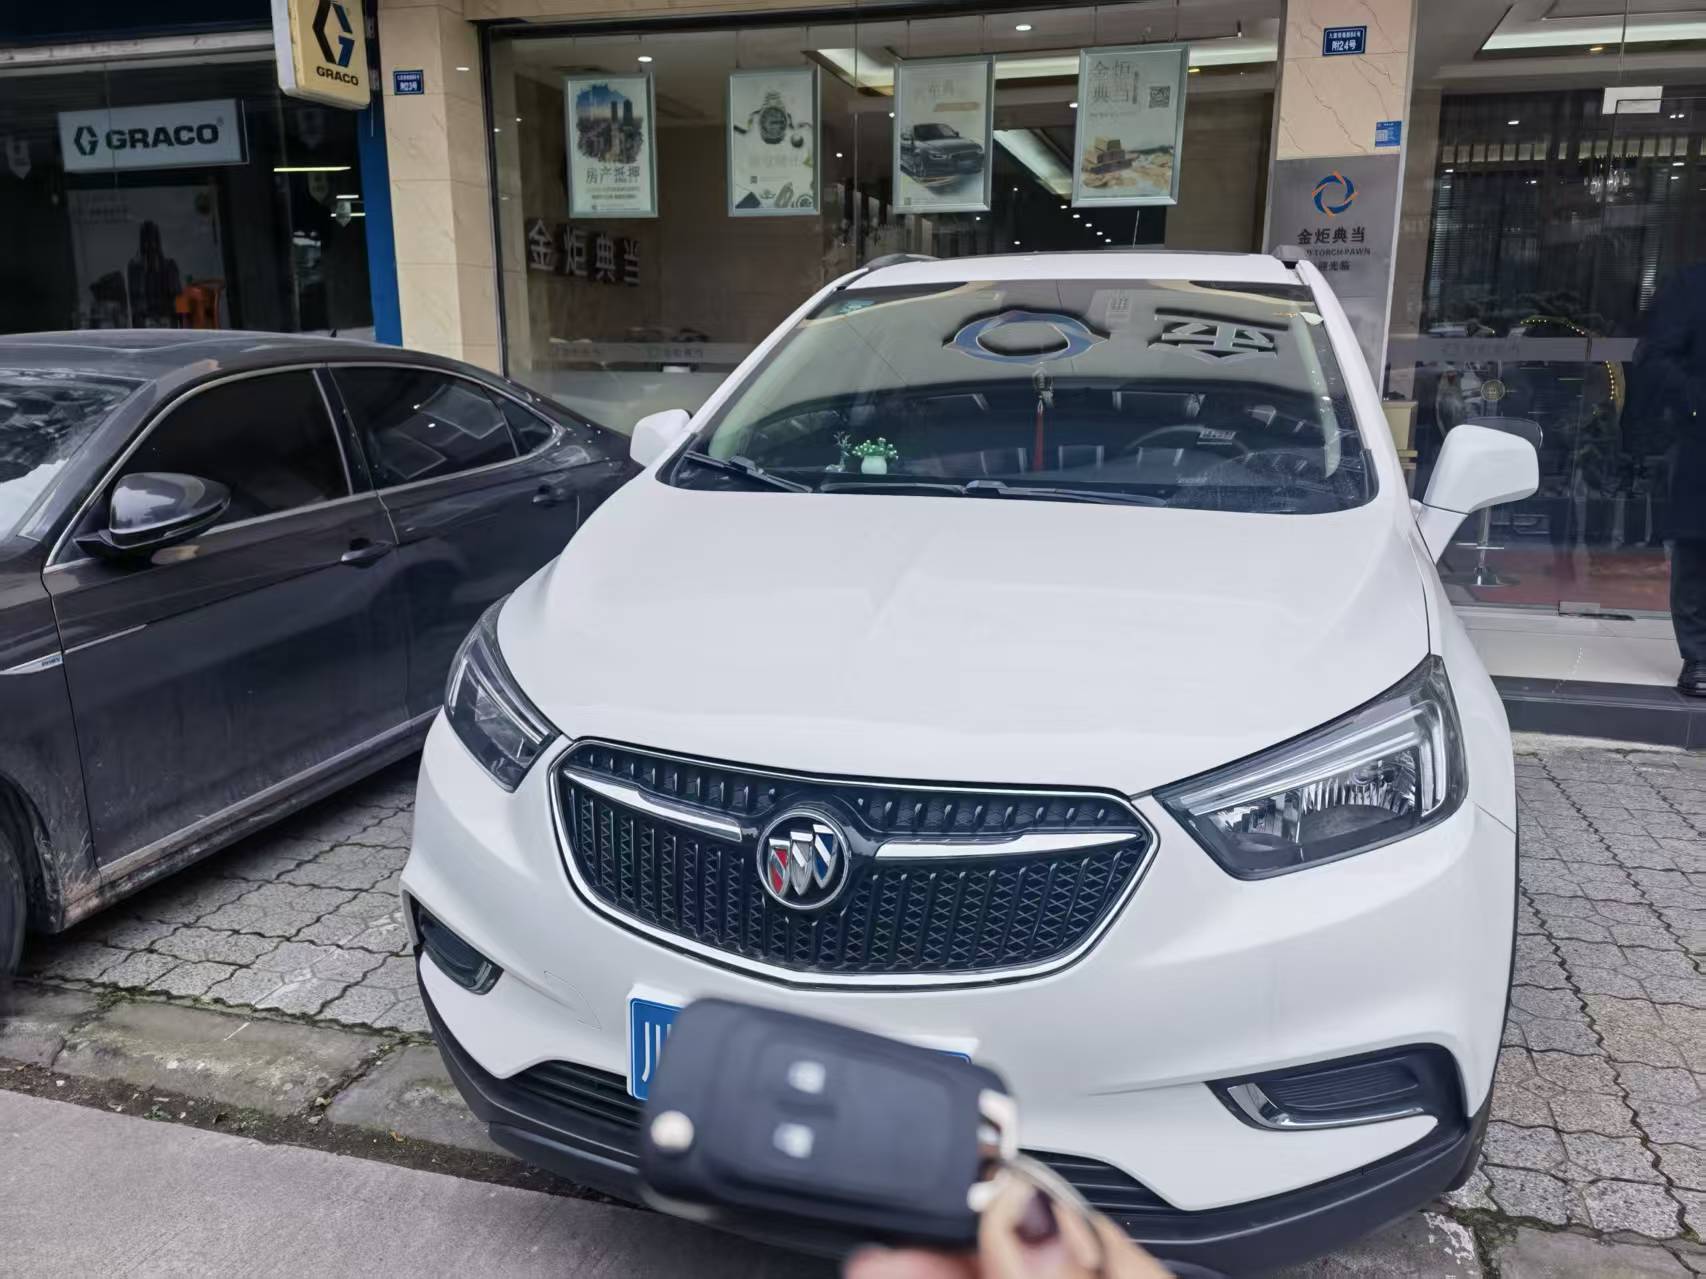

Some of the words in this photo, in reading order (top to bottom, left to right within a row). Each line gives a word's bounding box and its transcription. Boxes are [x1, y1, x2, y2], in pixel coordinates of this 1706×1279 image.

[1331, 39, 1357, 51] 附24号
[316, 66, 359, 87] GRACO
[105, 124, 219, 150] GRACO
[1297, 226, 1366, 245] 金炬典当
[528, 218, 641, 284] 金炬典当
[1344, 247, 1371, 256] PAWN
[1317, 260, 1351, 272] 迎光临
